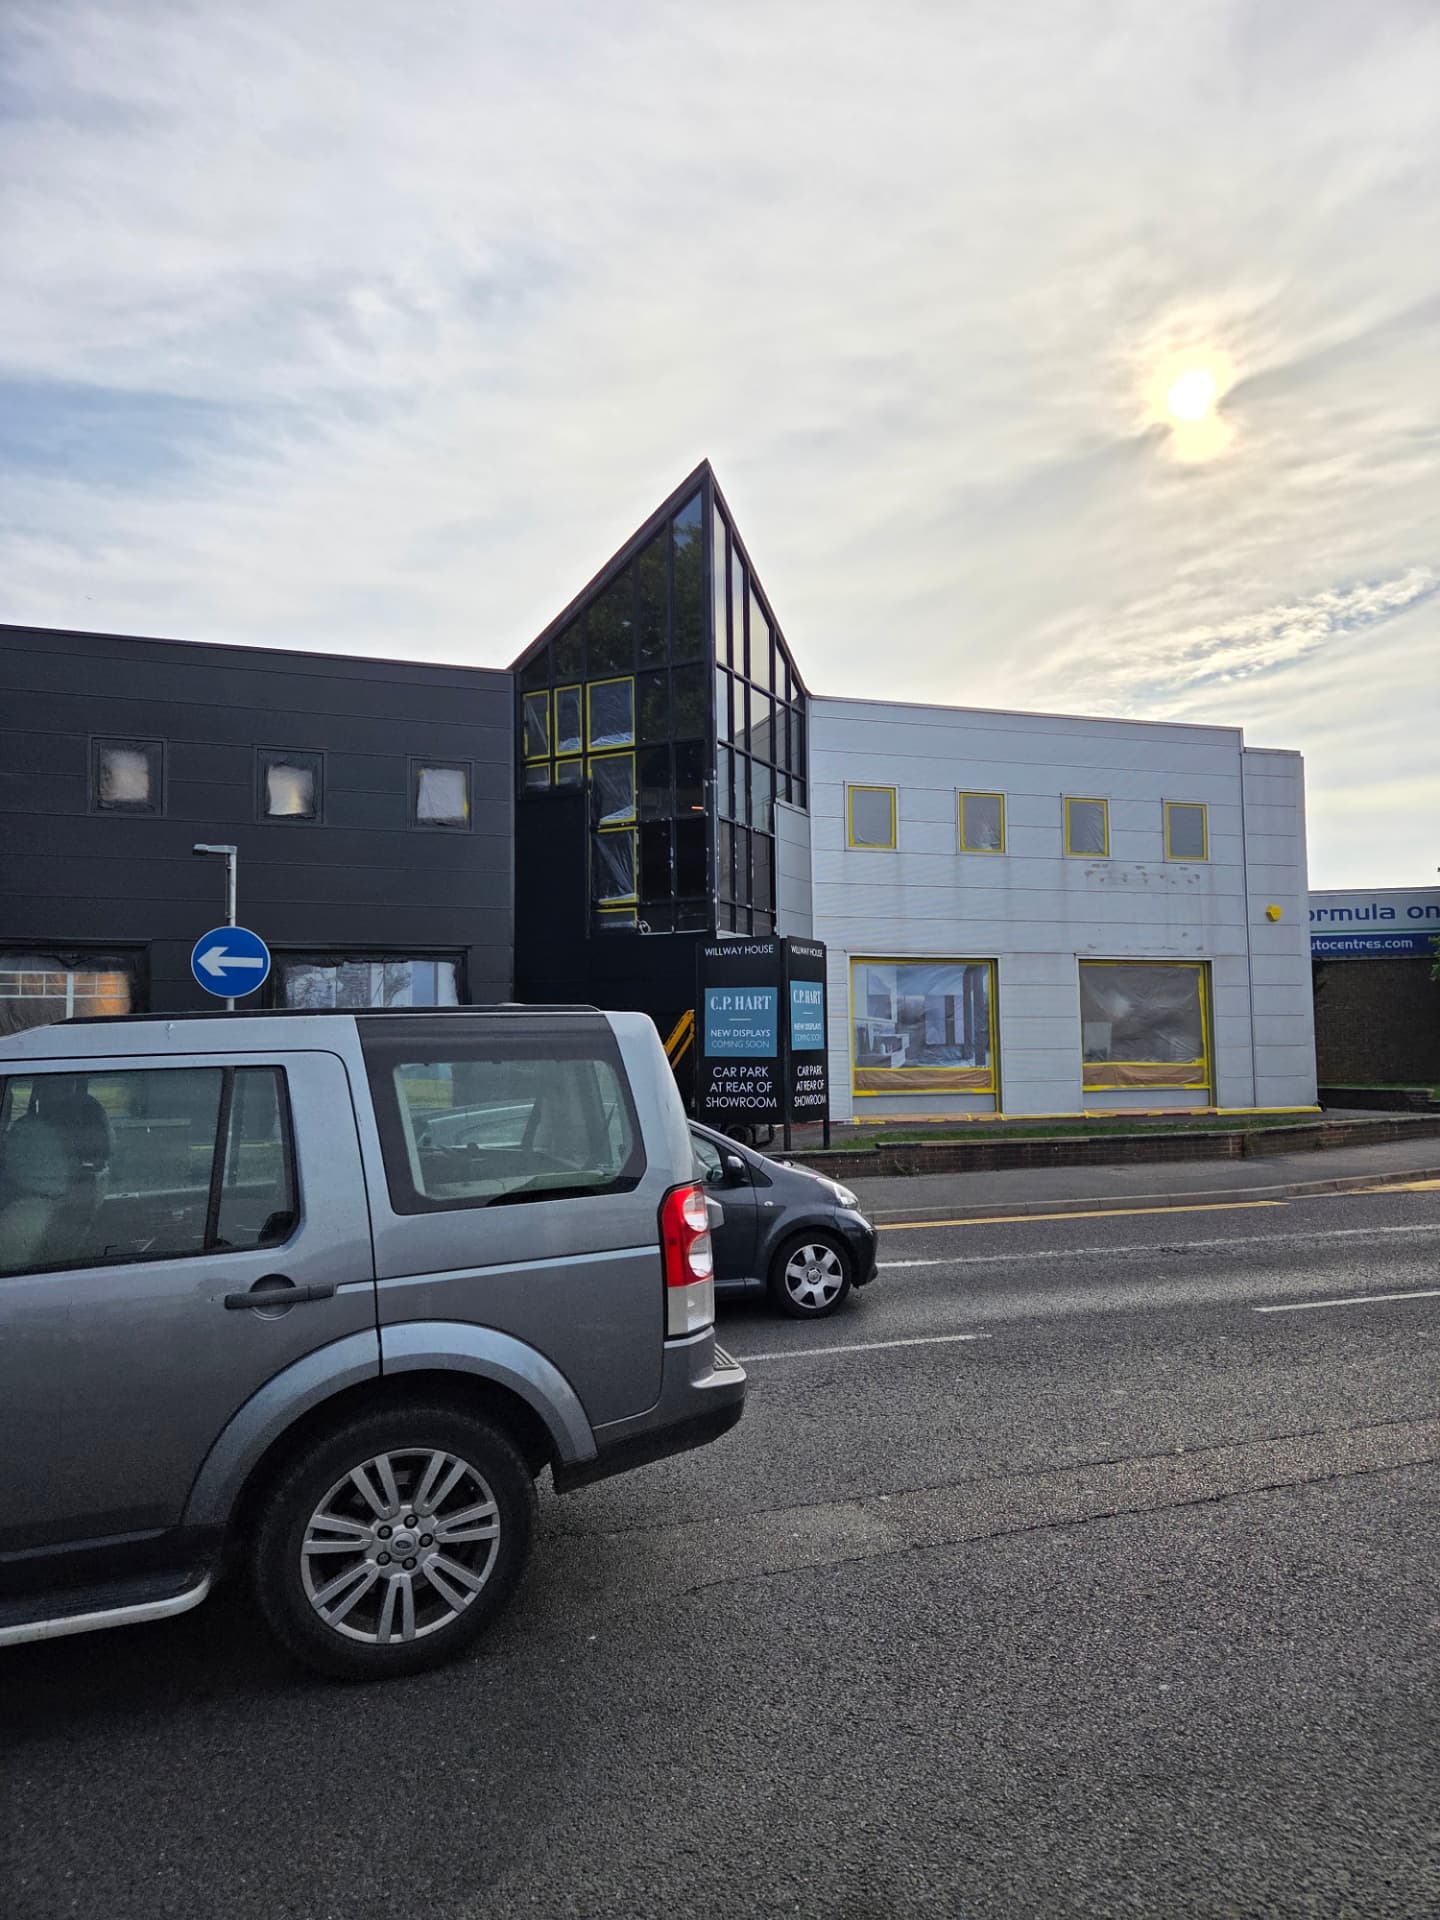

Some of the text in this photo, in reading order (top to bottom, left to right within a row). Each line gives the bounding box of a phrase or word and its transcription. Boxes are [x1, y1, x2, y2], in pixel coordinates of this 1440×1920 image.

[704, 944, 774, 956] WILLWAY HOUSE
[735, 995, 772, 1010] HART
[710, 1029, 771, 1038] NEW DISPLAYS
[711, 1040, 770, 1049] COMING SOON
[712, 1066, 769, 1078] CAR PARK
[797, 1064, 823, 1077] CAR PARK
[709, 1081, 773, 1093] AT REAR OF
[796, 1079, 824, 1091] AT REAR OF
[705, 1096, 778, 1108] SHOWROOM
[794, 1094, 826, 1107] SHOWROOM
